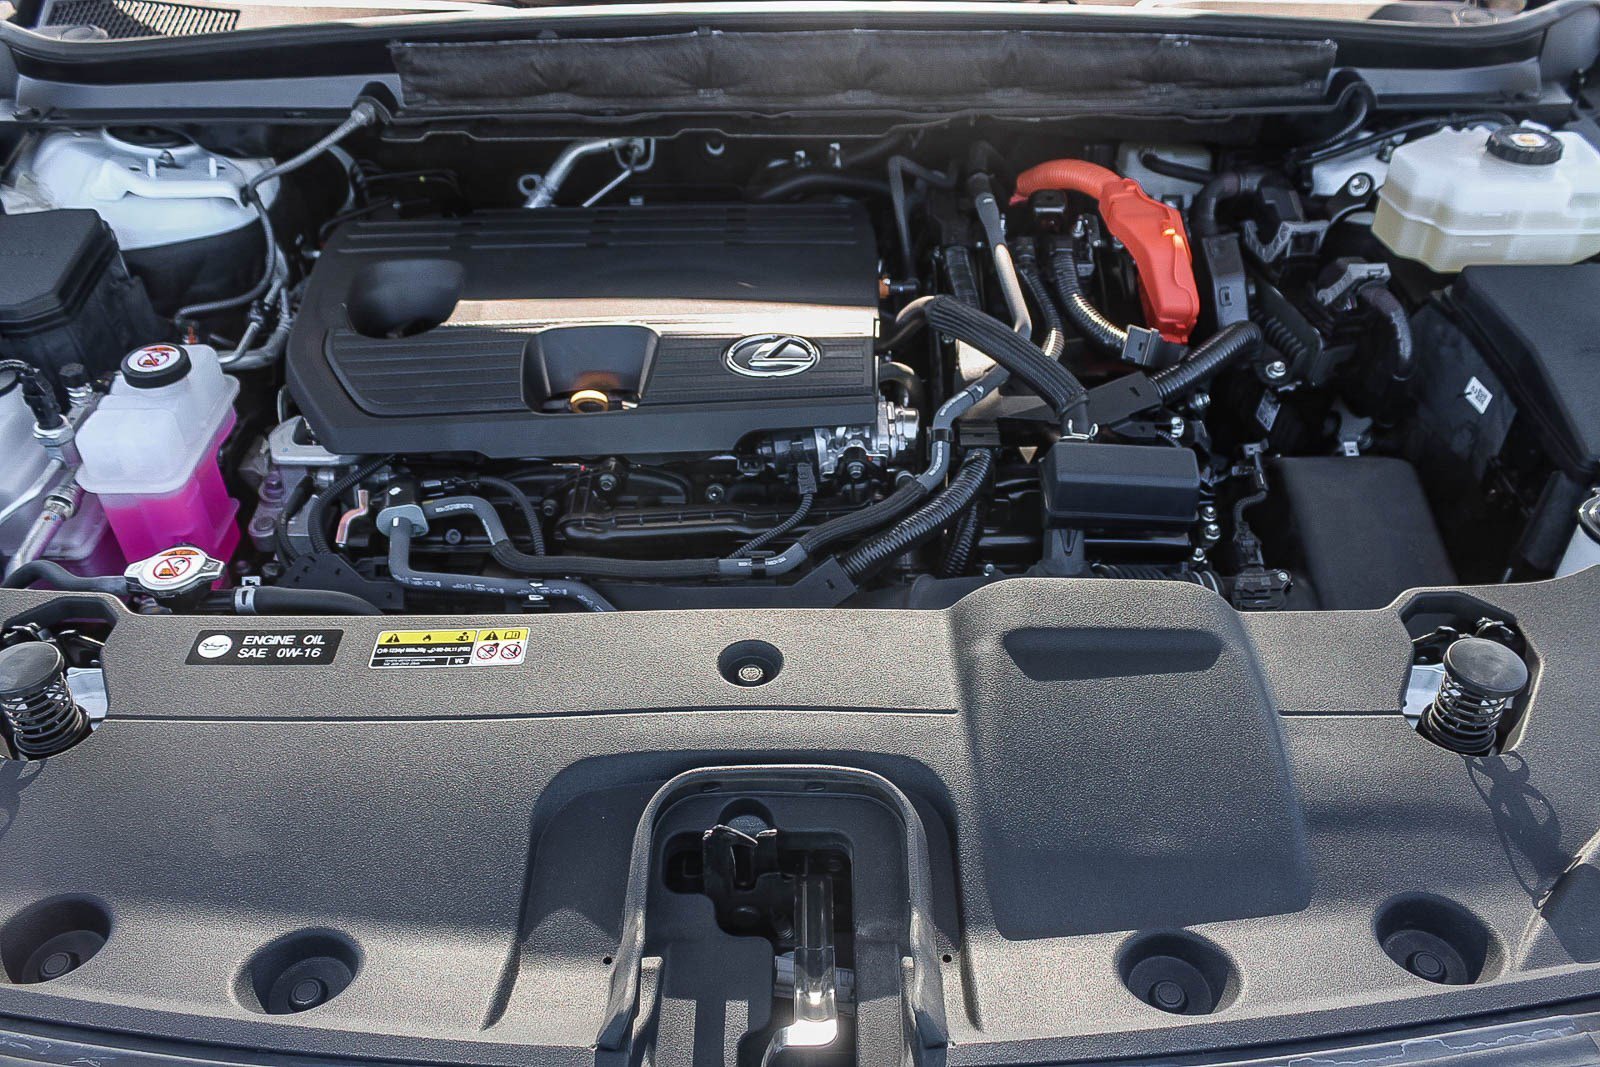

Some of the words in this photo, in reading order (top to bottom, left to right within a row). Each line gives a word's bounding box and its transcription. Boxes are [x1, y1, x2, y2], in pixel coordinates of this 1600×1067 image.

[242, 635, 296, 645] ENGINE
[302, 634, 326, 645] OIL
[237, 648, 269, 658] SAE
[276, 647, 322, 658] 0W-16
